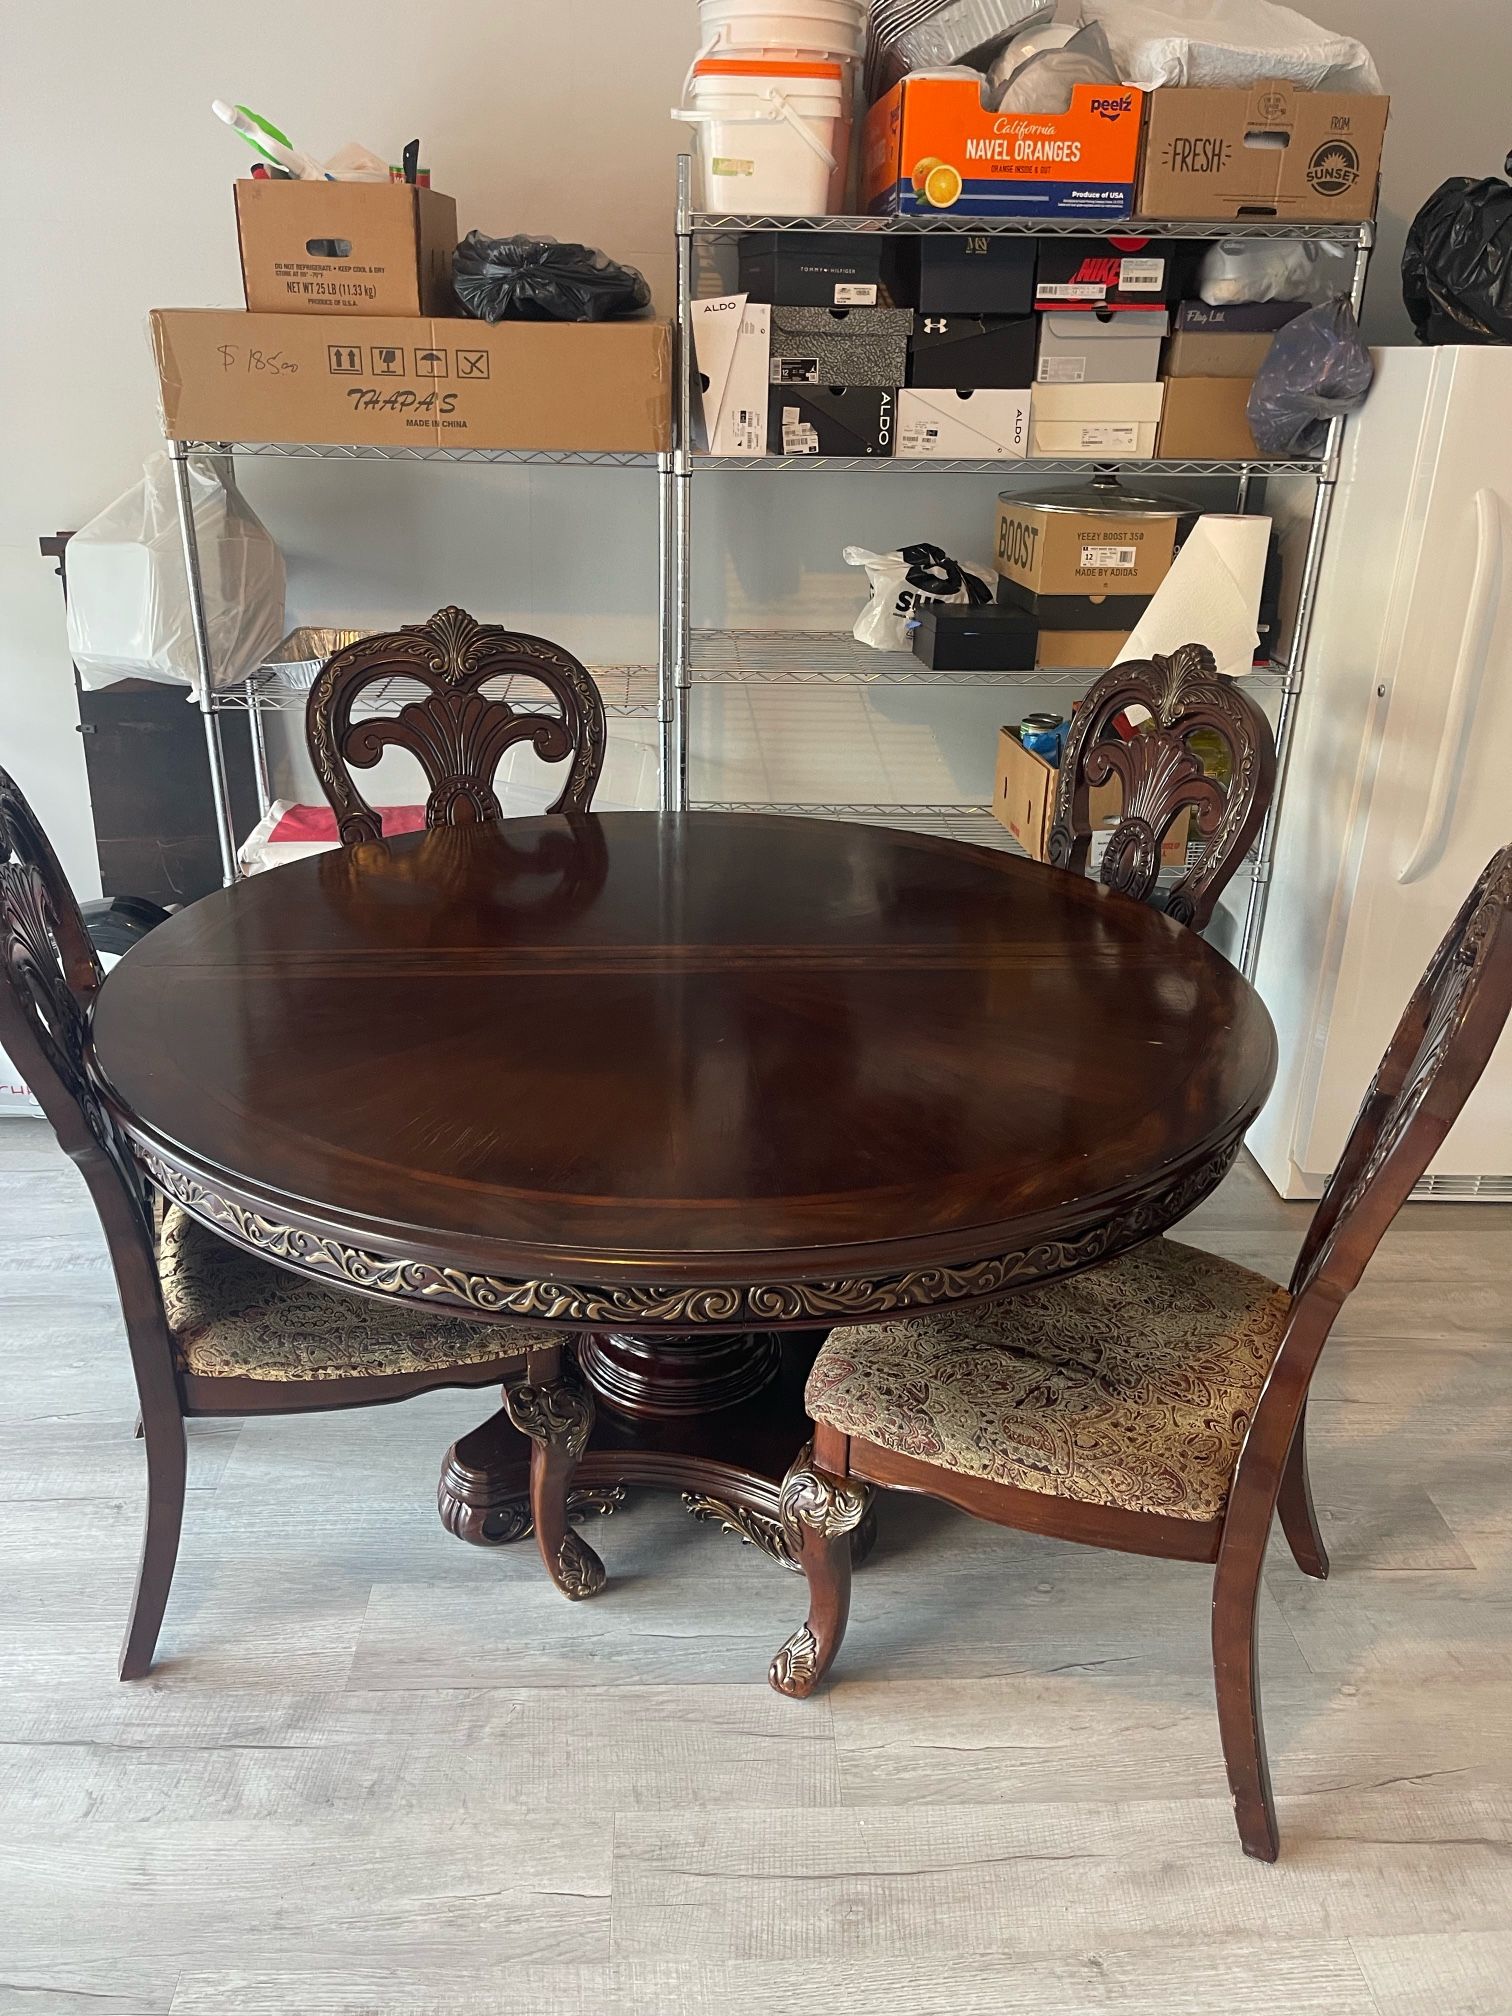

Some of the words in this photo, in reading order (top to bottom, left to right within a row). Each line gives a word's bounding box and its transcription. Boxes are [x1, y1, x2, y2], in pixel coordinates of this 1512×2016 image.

[1091, 96, 1132, 113] peelz
[993, 118, 1056, 139] California
[1330, 116, 1350, 130] FROM
[966, 139, 1011, 161] NAVEL
[1015, 140, 1081, 162] ORANGES
[1171, 138, 1223, 173] FRESH
[1306, 168, 1360, 185] SUNSET
[1076, 258, 1121, 282] NIKE
[287, 281, 300, 293] NET
[302, 282, 314, 294] WT
[316, 283, 326, 295] 25
[327, 283, 337, 295] LB
[339, 284, 362, 297] (11.33
[364, 284, 377, 299] kg)
[704, 302, 737, 313] ALDO
[347, 388, 459, 414] THAPA'S
[406, 419, 430, 428] MADE
[431, 420, 440, 428] IN
[442, 420, 468, 429] CHINA
[878, 391, 891, 445] ALDO
[1014, 409, 1023, 445] ALDO
[998, 516, 1039, 572] BOOST
[1077, 532, 1101, 541] YEEZY
[1103, 532, 1127, 541] BOOST
[1129, 532, 1144, 541] 350
[1085, 553, 1093, 561] 12
[1075, 568, 1097, 577] MADE
[1098, 568, 1109, 577] BY
[1110, 569, 1138, 577] ADIDAS
